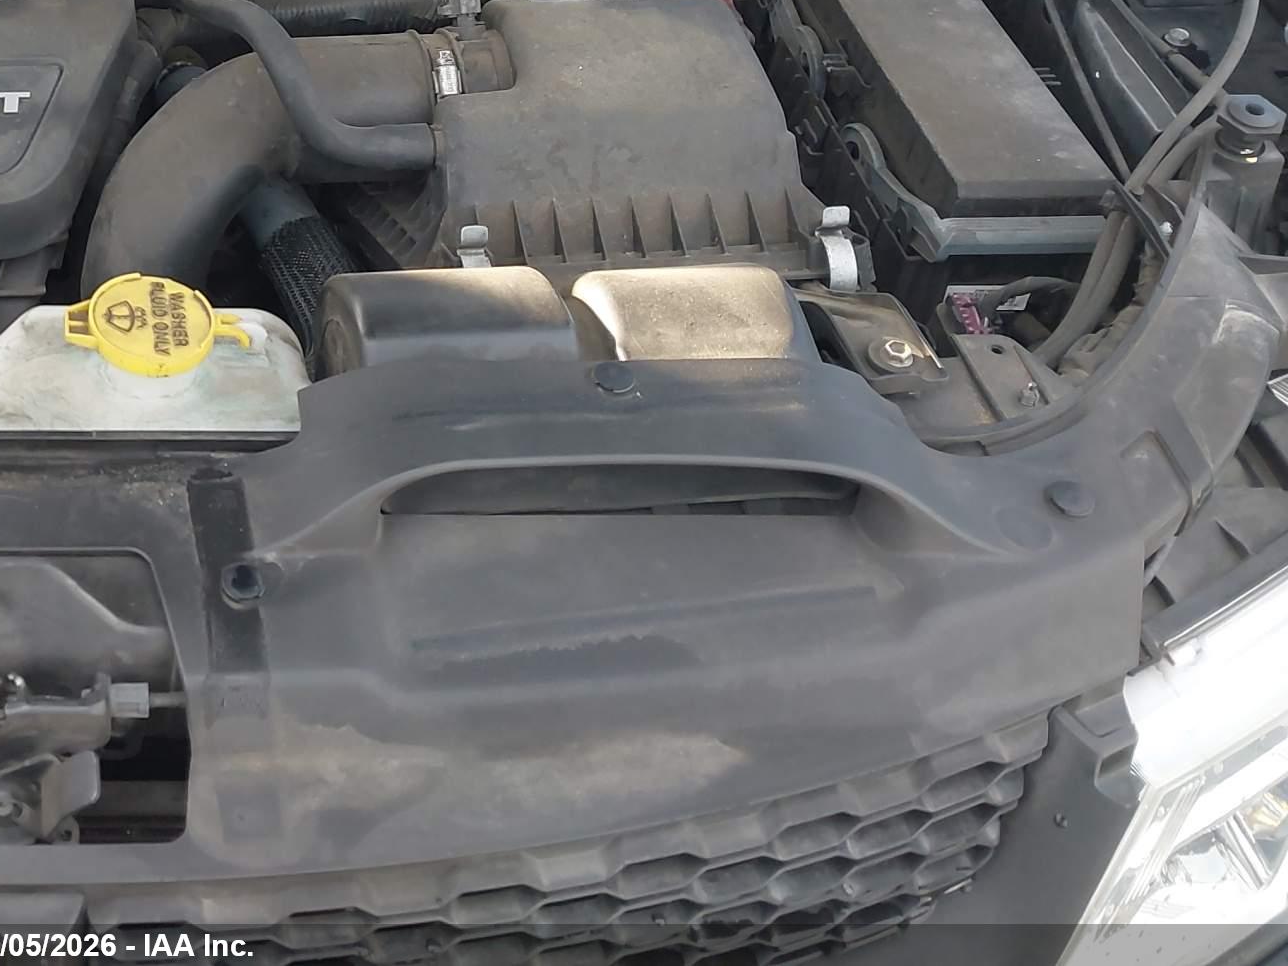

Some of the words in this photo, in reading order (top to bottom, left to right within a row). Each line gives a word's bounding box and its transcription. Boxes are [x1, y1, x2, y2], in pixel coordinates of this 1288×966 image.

[150, 281, 169, 318] FLUID
[168, 291, 189, 347] WASHER
[151, 321, 171, 356] ONLY
